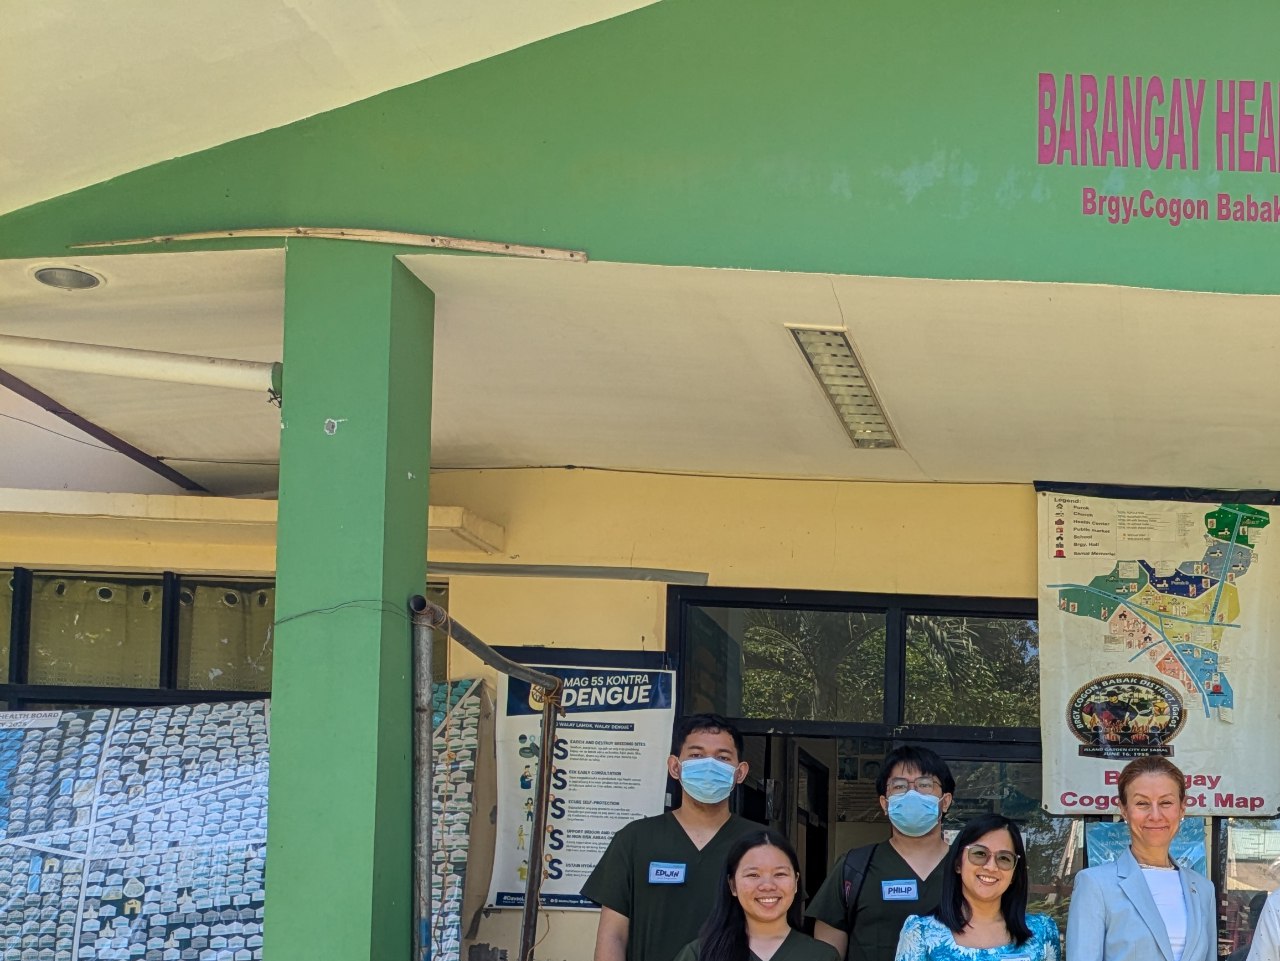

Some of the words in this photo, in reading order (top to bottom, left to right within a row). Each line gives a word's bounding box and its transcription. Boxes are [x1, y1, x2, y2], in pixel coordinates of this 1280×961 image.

[1038, 72, 1206, 171] BARANGAY
[1082, 188, 1209, 227] Brgy.Cogon
[564, 678, 589, 687] MAG
[591, 676, 604, 686] 5S
[606, 674, 649, 686] KONTRA
[1102, 678, 1138, 687] BABAK
[561, 685, 652, 707] DENGUE
[1214, 793, 1265, 811] Map
[655, 869, 679, 877] EDWIN
[888, 886, 912, 894] PHILIP
